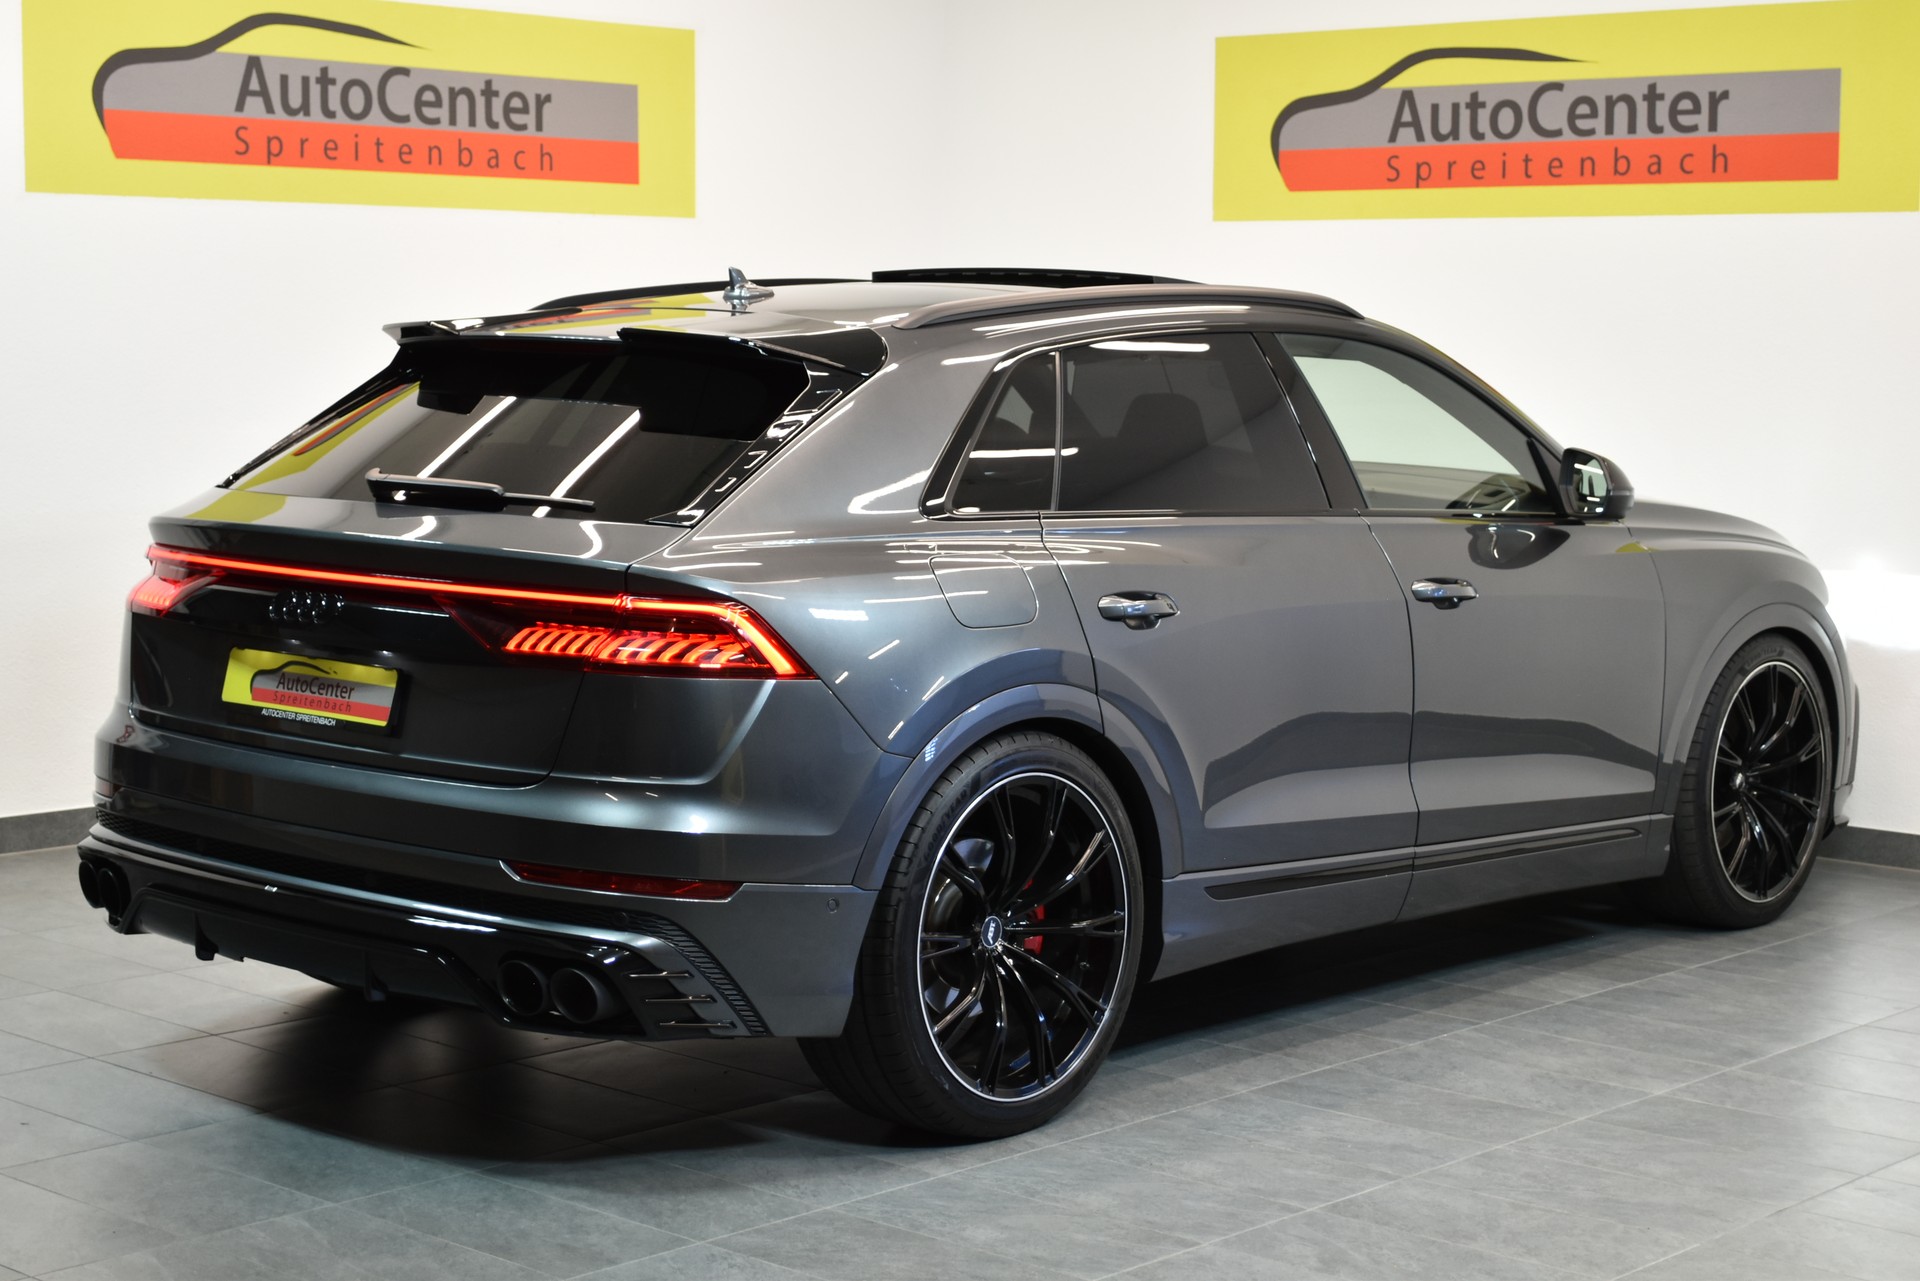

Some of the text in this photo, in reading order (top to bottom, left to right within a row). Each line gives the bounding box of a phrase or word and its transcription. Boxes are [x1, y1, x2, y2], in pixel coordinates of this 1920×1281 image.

[234, 55, 552, 133] AutoCenter
[1387, 82, 1730, 144] AutoCenter
[234, 126, 555, 172] Spreitenbach
[1386, 143, 1729, 188] Spreitenbach
[273, 690, 352, 713] Spreitenbach
[276, 672, 355, 700] AutoCenter
[261, 708, 336, 726] AUTOCENTER SPREITENBACH
